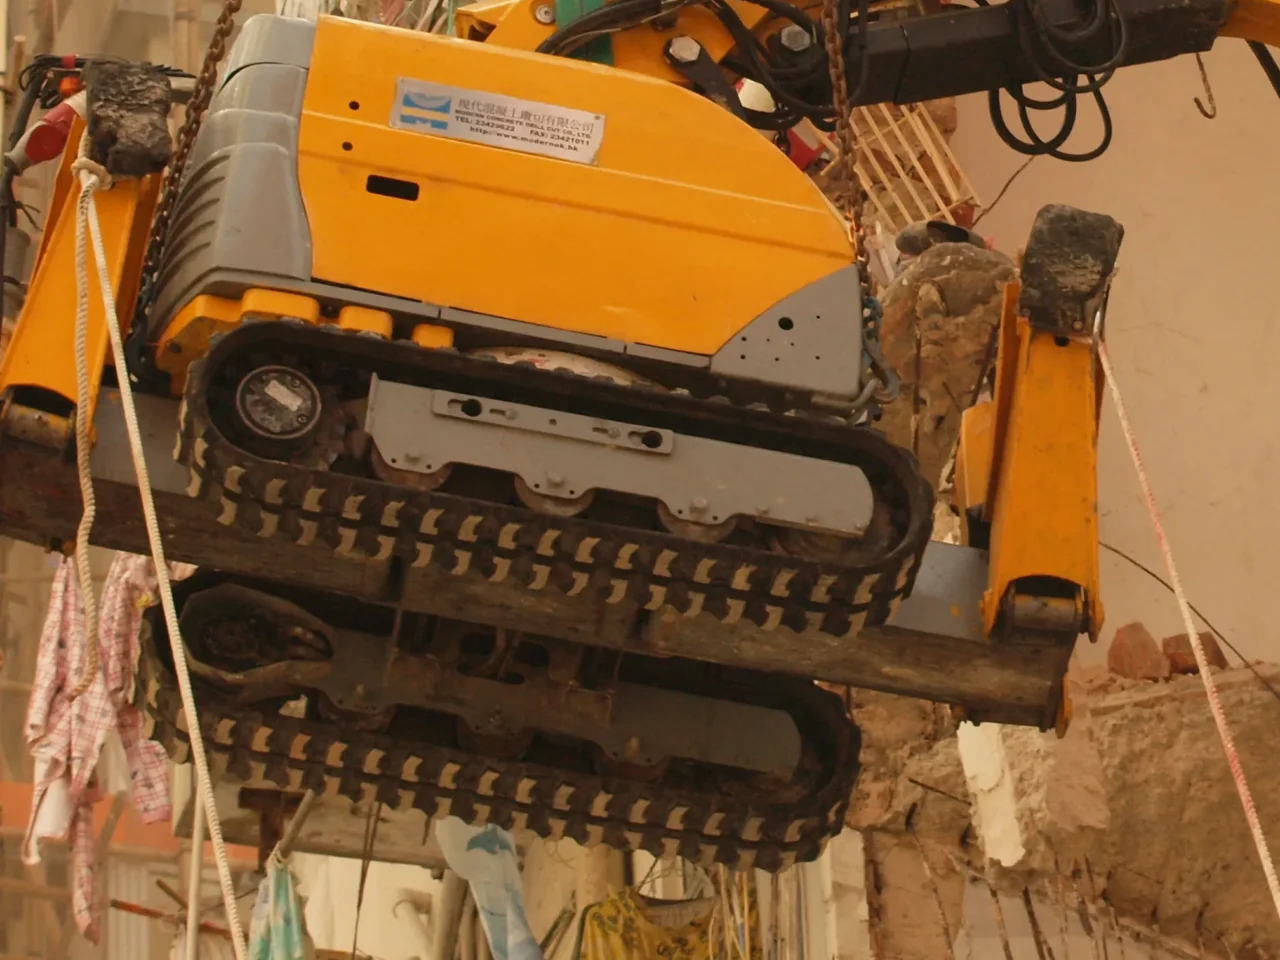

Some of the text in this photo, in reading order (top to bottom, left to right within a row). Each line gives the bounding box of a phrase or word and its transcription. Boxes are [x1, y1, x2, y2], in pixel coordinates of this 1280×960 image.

[455, 109, 485, 119] MODERN
[486, 114, 524, 126] CONCRETE
[525, 122, 545, 131] DRILL
[455, 115, 473, 124] TEL:
[530, 129, 548, 138] FAX:
[550, 133, 590, 146] 23421011
